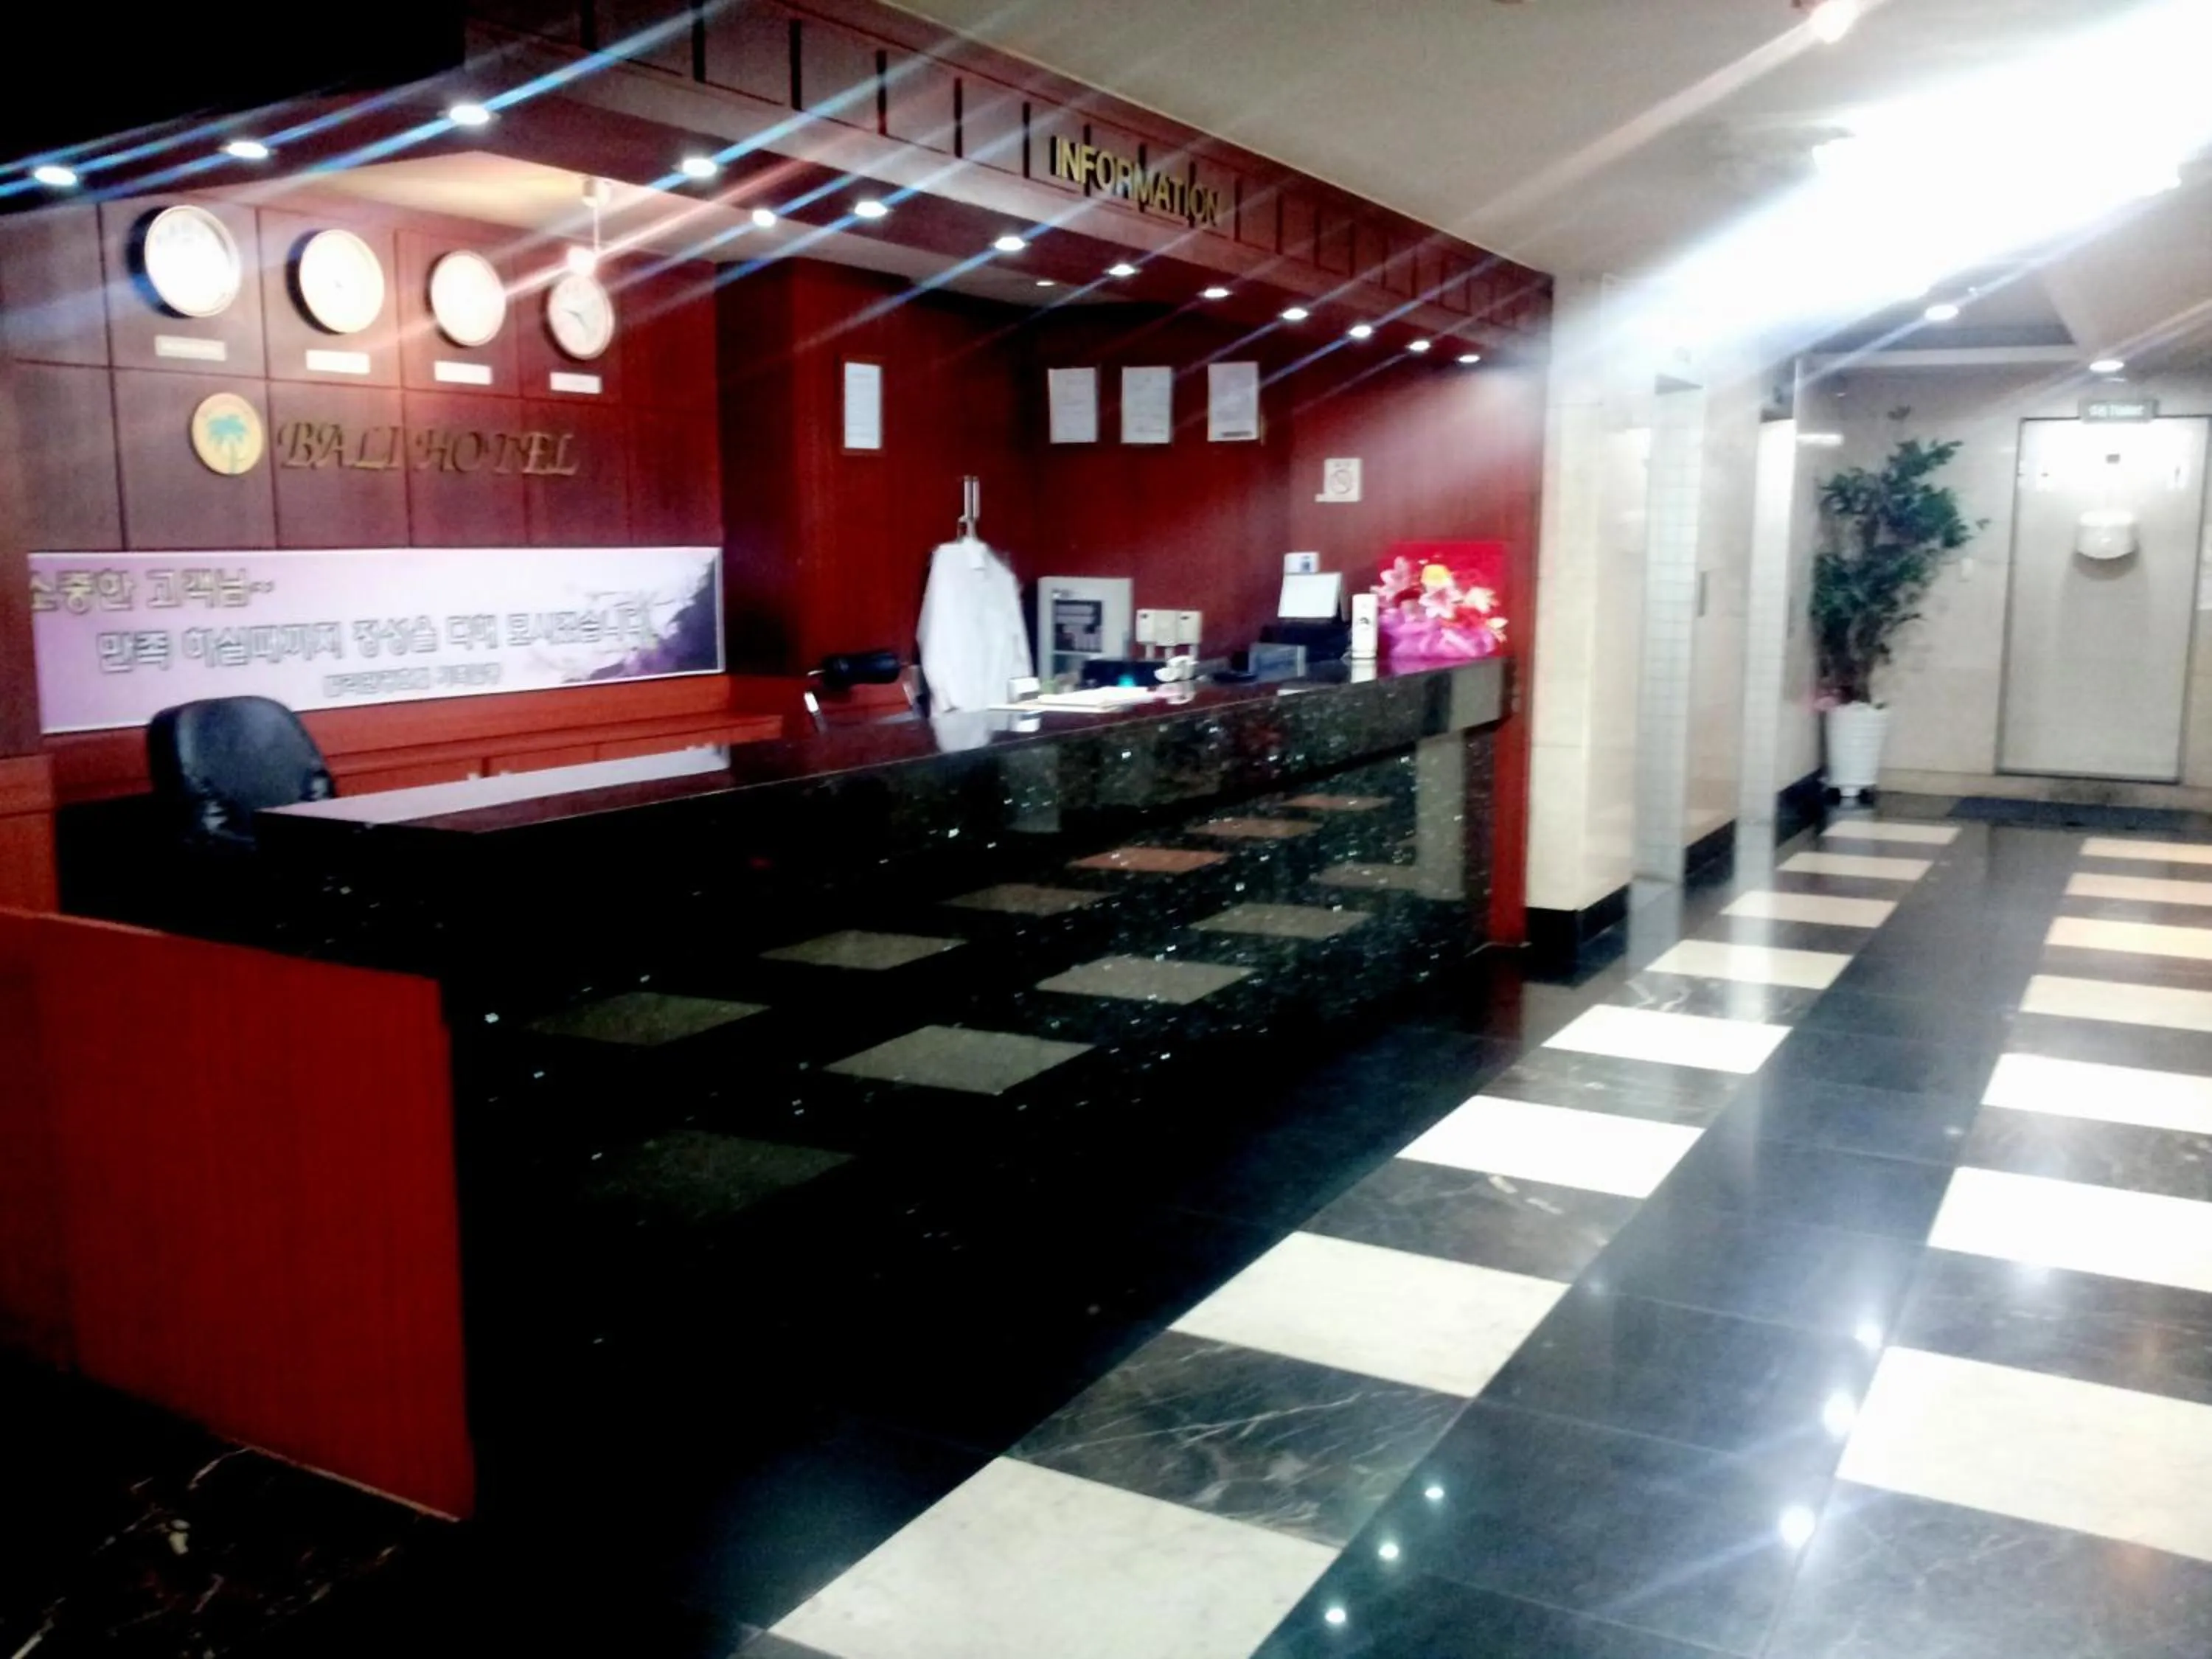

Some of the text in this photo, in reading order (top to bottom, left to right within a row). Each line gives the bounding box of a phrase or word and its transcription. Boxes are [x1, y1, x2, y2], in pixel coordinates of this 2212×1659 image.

[1054, 136, 1219, 226] INFORMATION
[277, 420, 580, 476] BALI HOTEL
[97, 628, 173, 674] 만족
